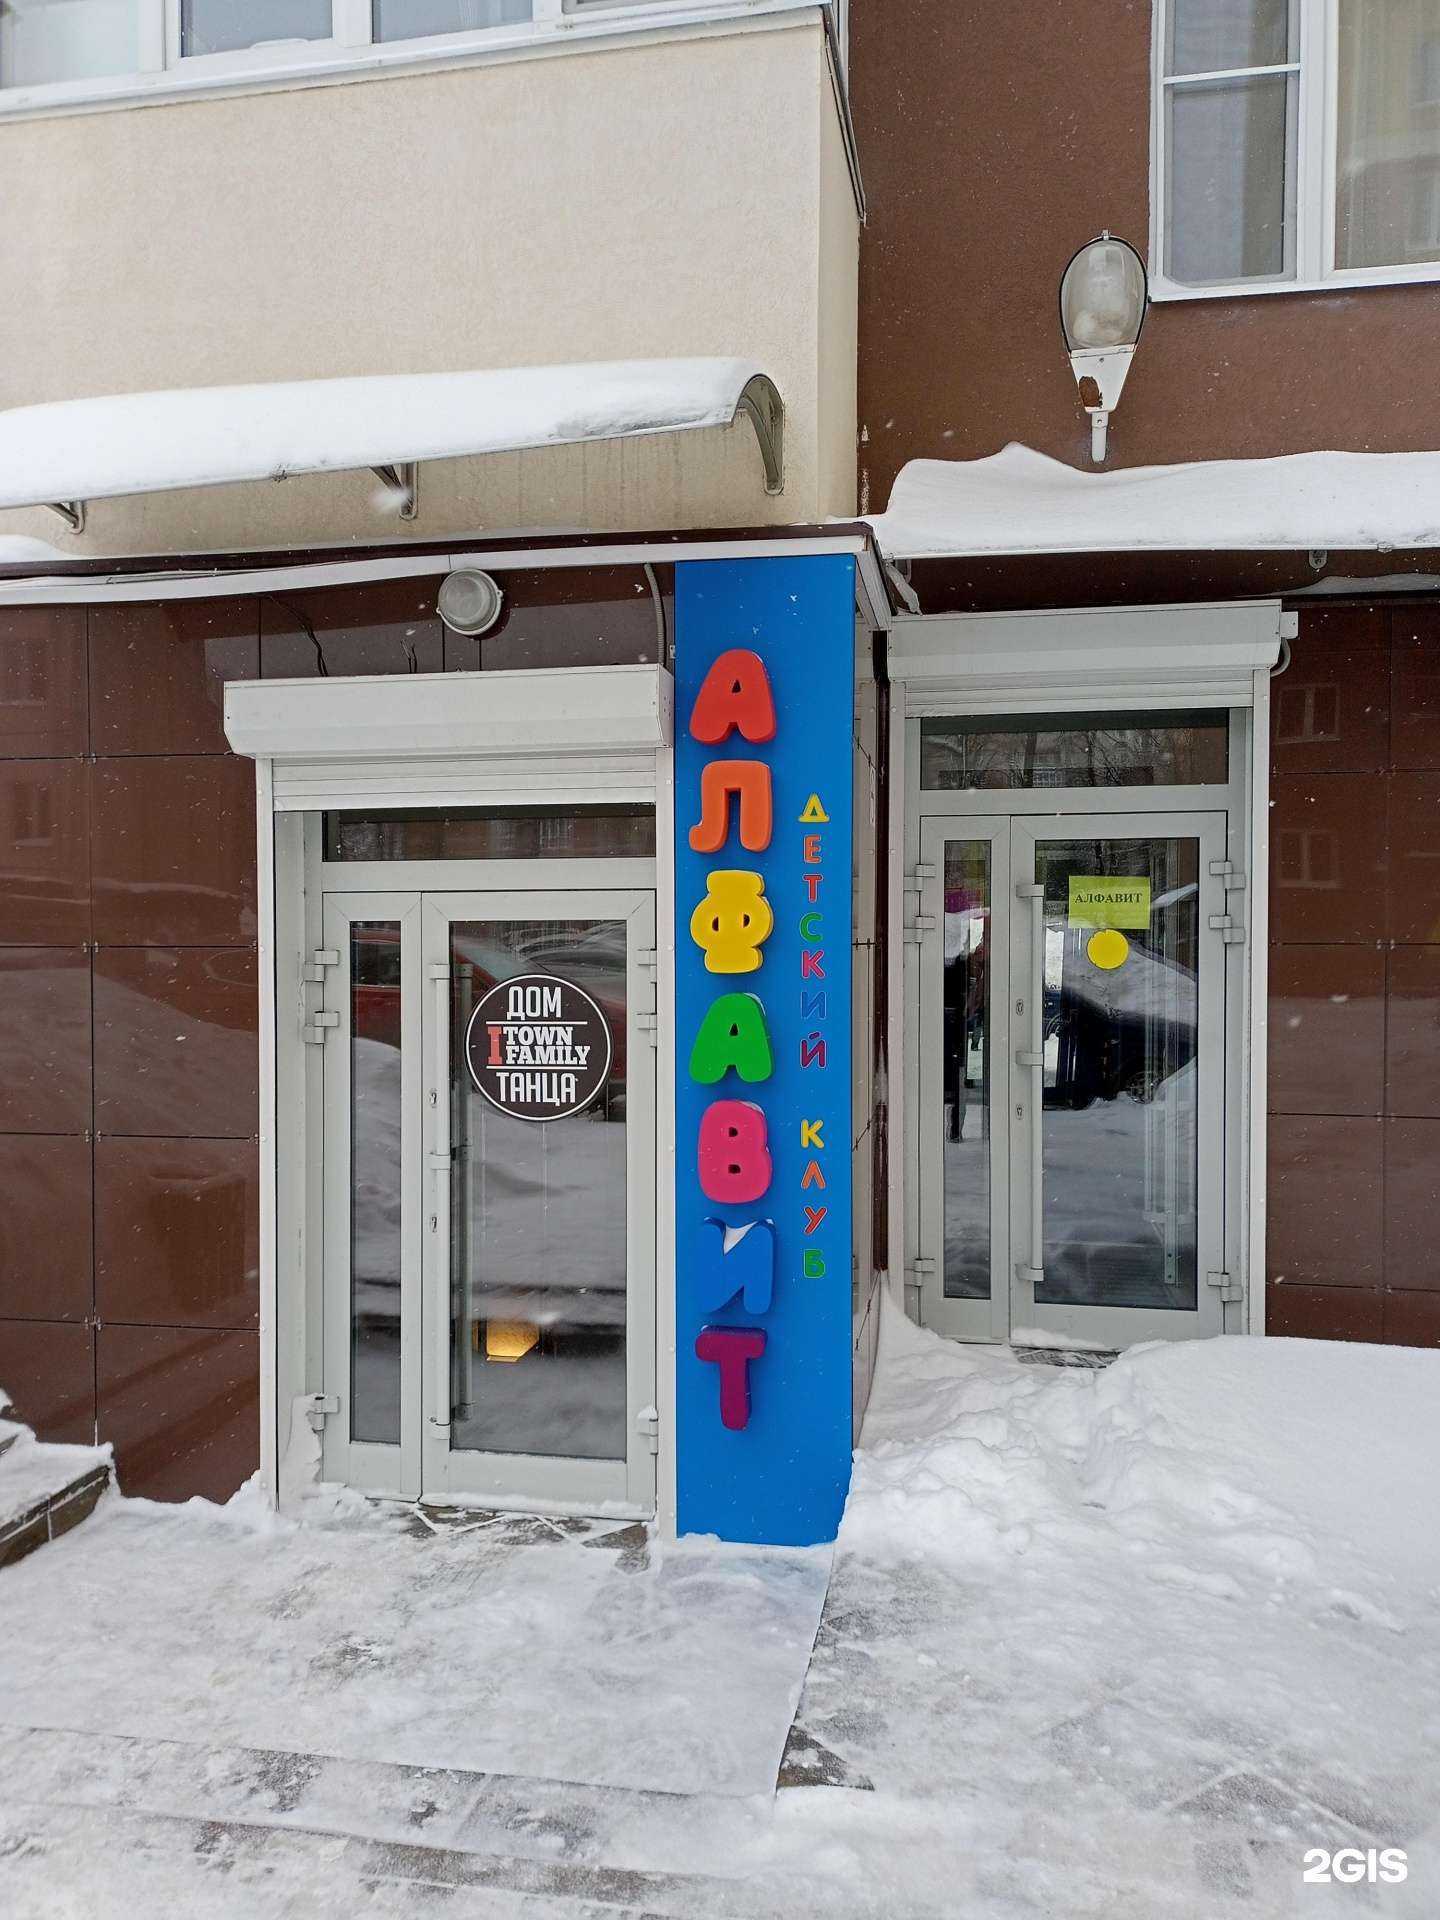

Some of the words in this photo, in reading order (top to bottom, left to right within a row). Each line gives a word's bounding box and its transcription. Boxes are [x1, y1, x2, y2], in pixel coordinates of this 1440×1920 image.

[1074, 893, 1143, 904] АЛФАВИТ
[797, 793, 830, 1068] ДЕТСКИЙ
[506, 986, 562, 1020] ДОМ
[503, 1026, 573, 1046] TOWN
[688, 647, 777, 1431] АЛФАВИТ
[505, 1045, 591, 1065] FAMILY
[496, 1072, 576, 1106] ТАНЦА
[800, 1118, 828, 1279] КЛУБ
